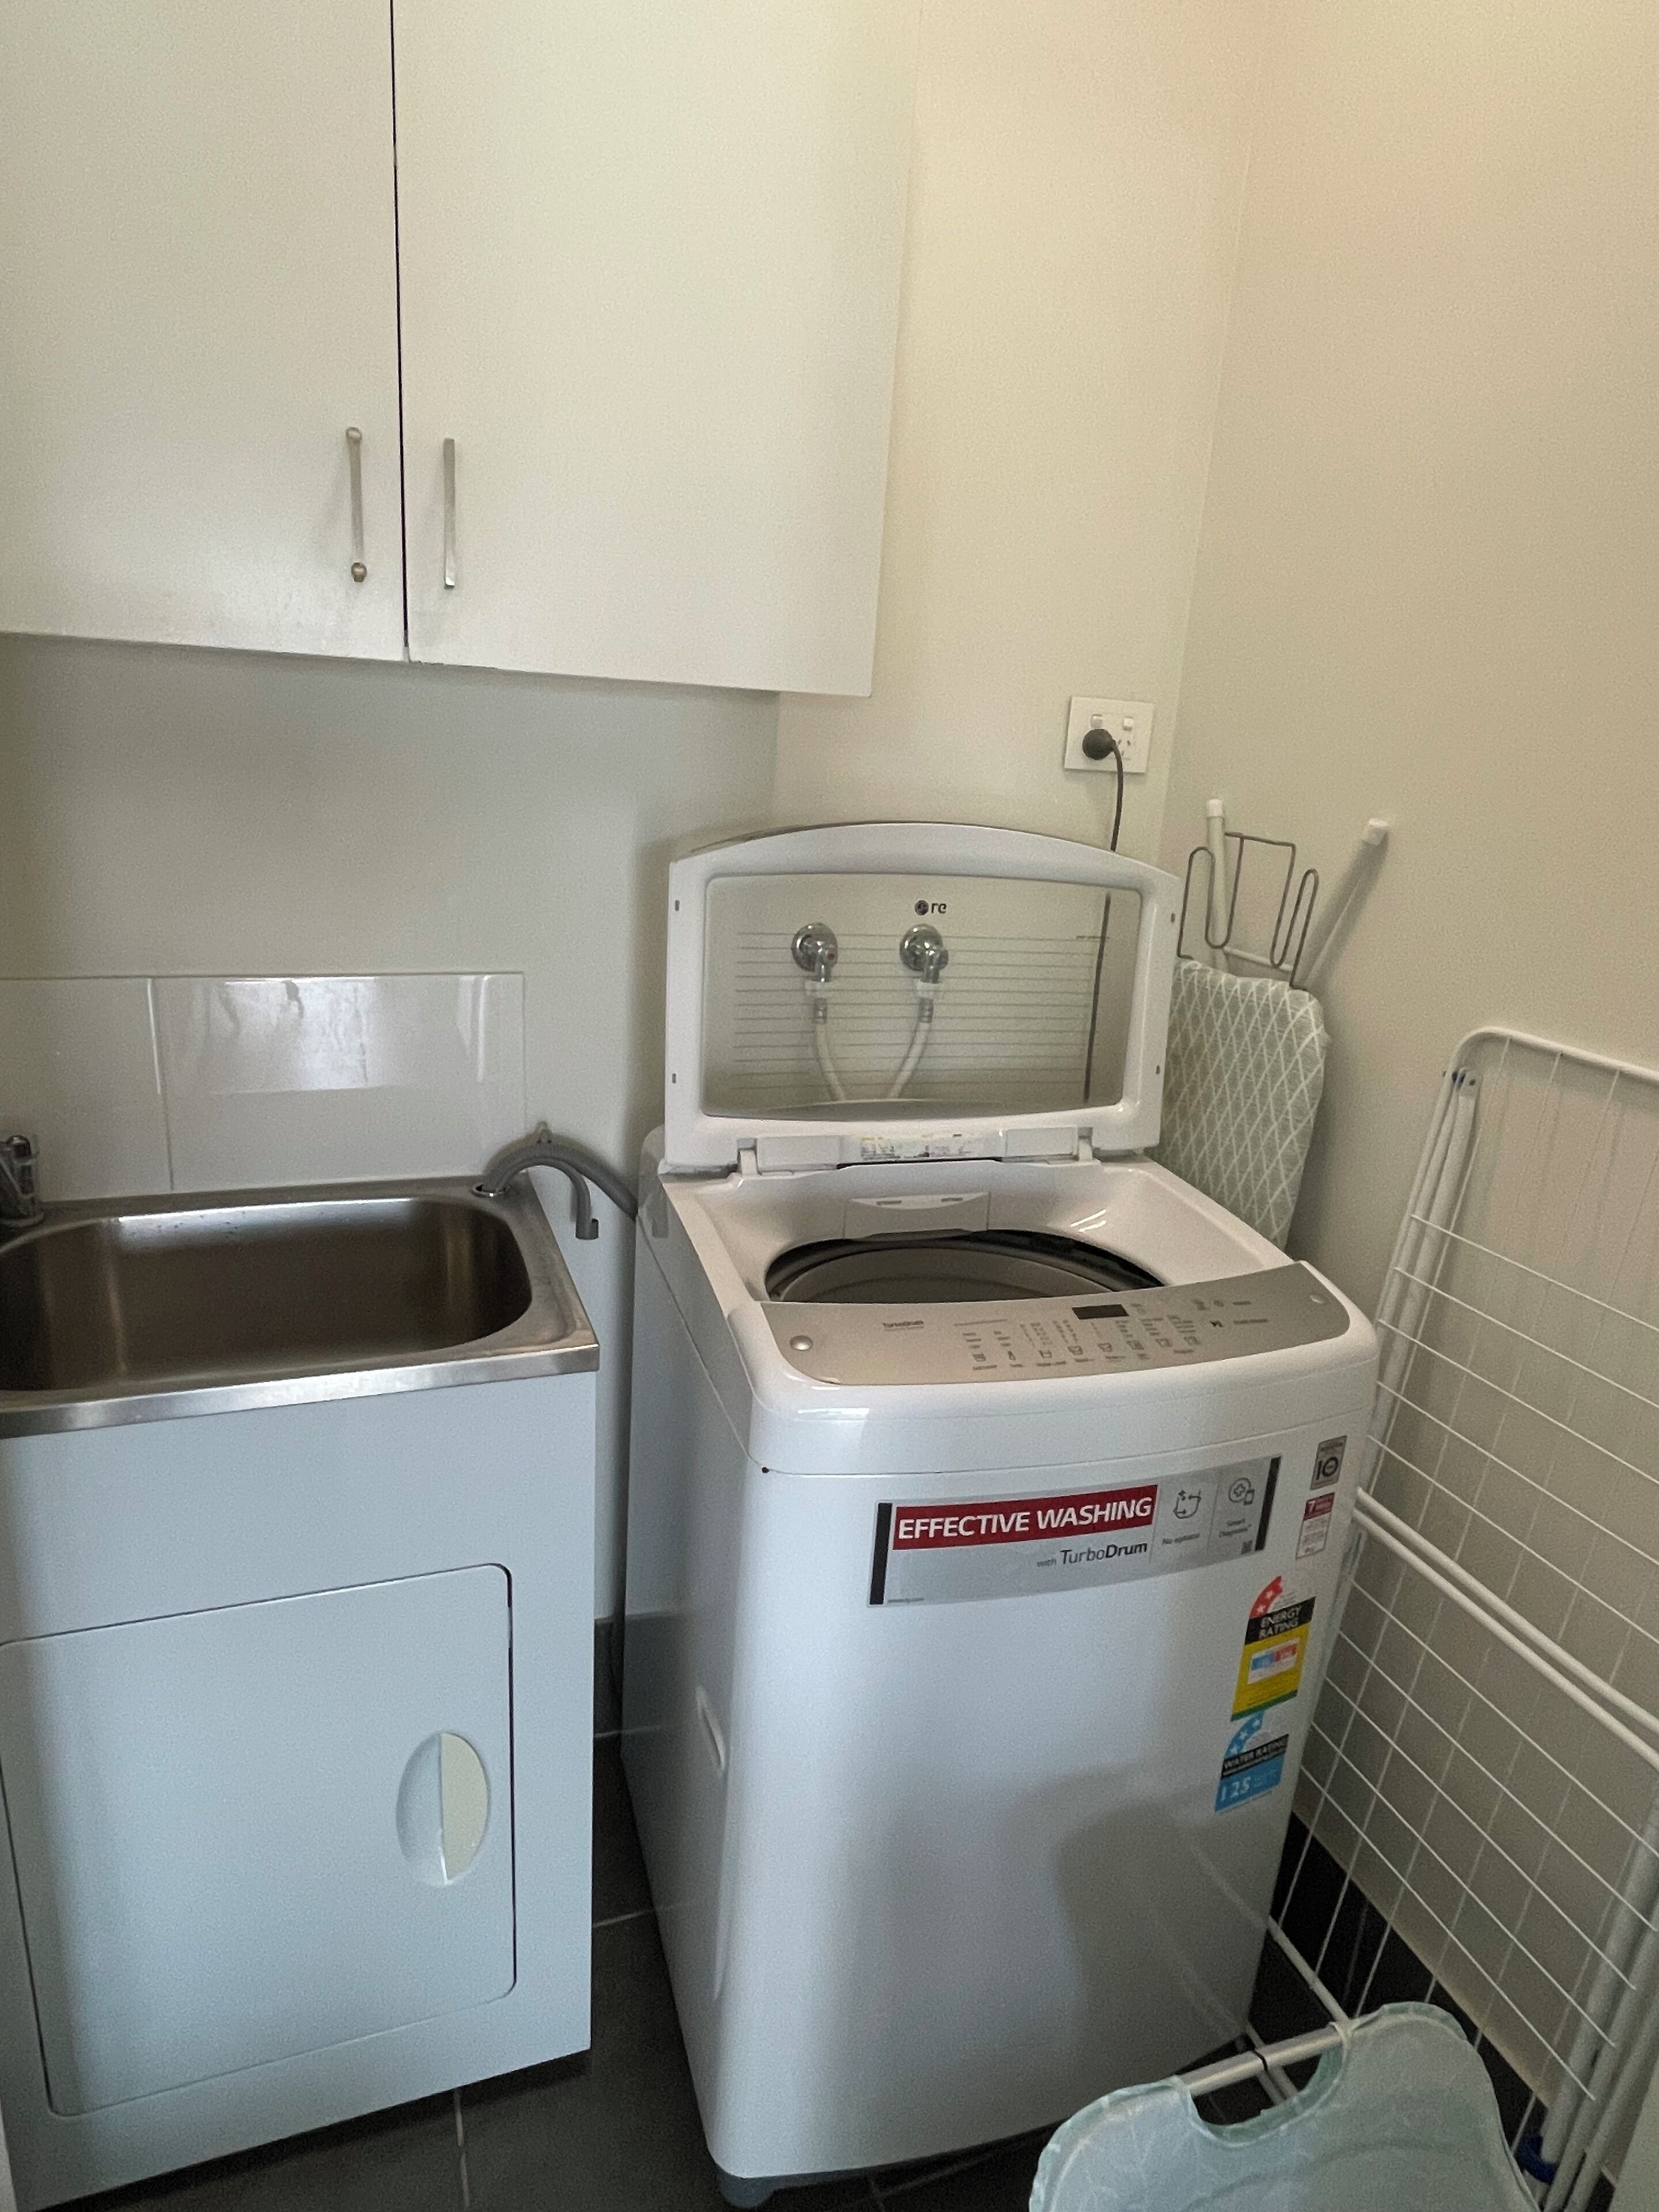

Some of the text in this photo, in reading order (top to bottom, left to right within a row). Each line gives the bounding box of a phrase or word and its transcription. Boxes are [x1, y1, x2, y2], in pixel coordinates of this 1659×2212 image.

[899, 1497, 1152, 1539] EFFECTIVE WASHING
[1059, 1542, 1148, 1565] TurboDrum
